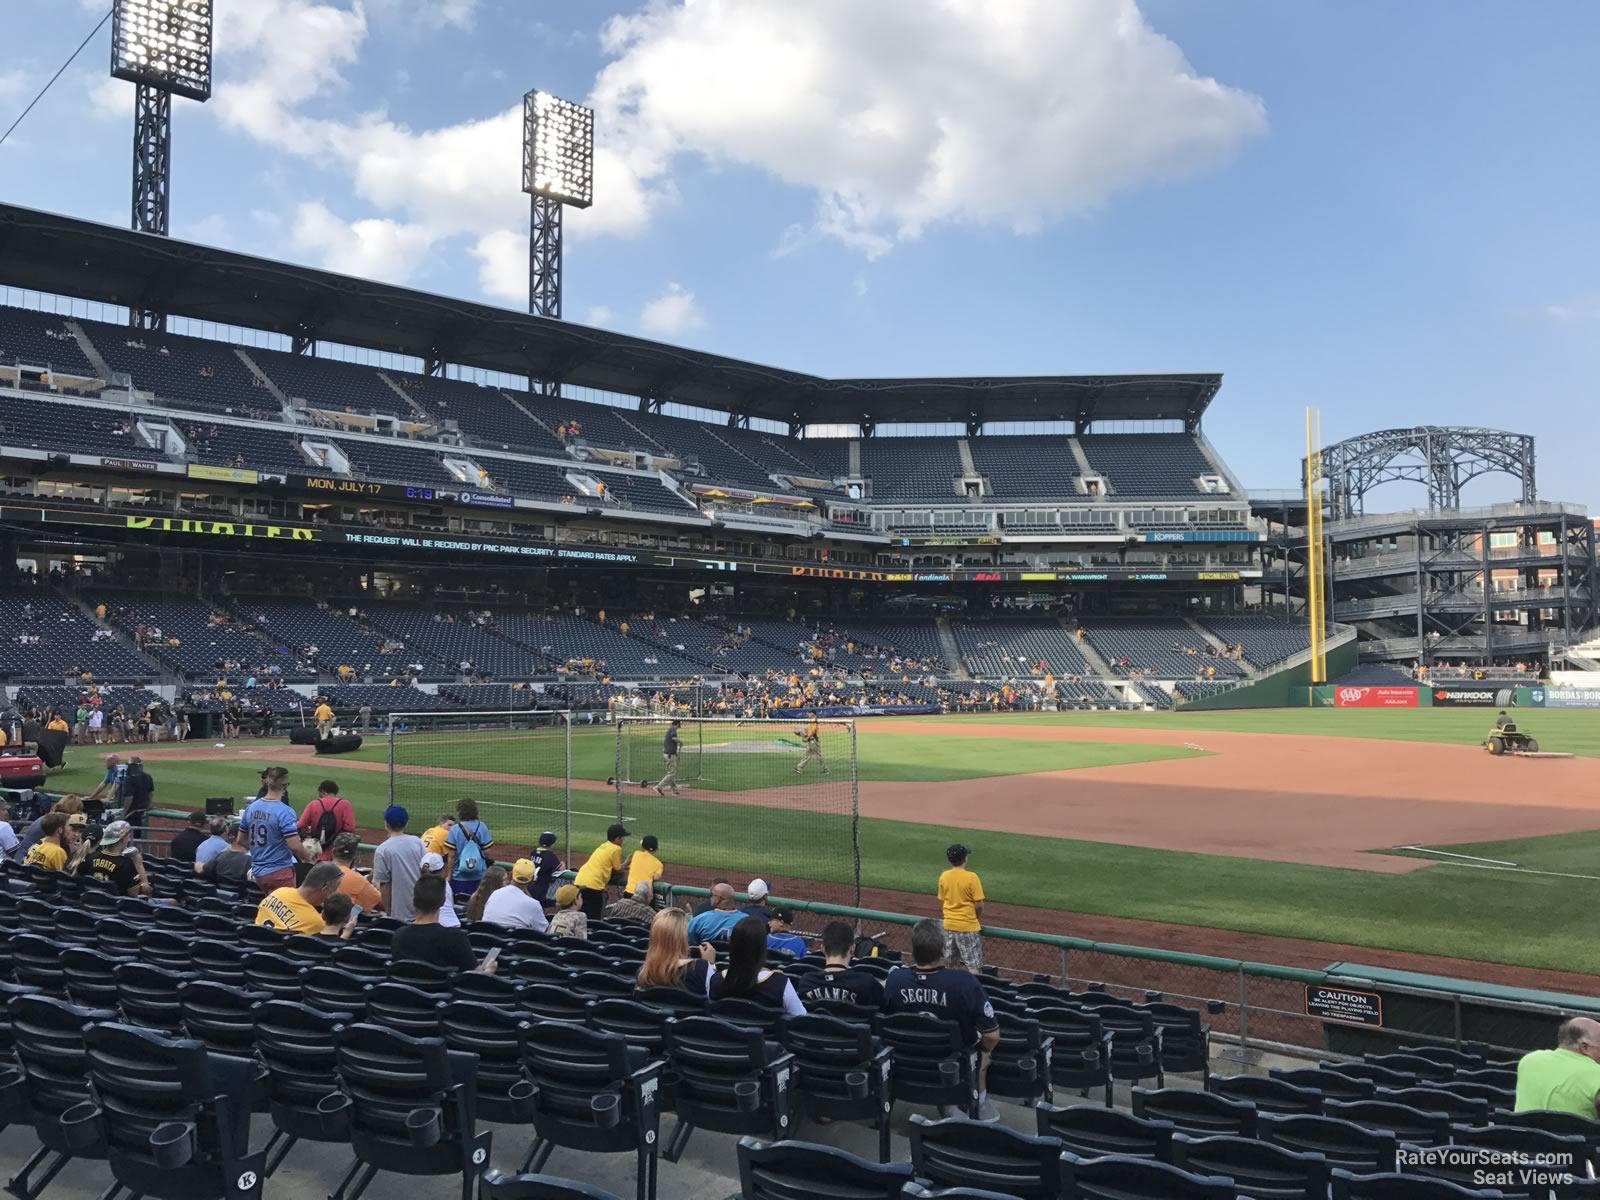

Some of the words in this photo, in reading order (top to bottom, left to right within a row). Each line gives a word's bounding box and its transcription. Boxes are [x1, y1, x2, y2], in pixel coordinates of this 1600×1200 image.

[104, 459, 121, 467] PAUL
[132, 461, 155, 470] WANER
[307, 478, 337, 491] MON,
[338, 482, 365, 493] JULY
[368, 484, 381, 494] 17
[472, 493, 511, 504] Consolidated
[1154, 532, 1184, 540] KOPPERS
[345, 533, 361, 542] THE
[363, 535, 400, 545] REQUEST
[402, 538, 421, 546] WILL
[434, 541, 470, 550] RECEIVED
[471, 543, 483, 551] BY
[483, 544, 499, 552] PNC
[500, 545, 519, 553] PARK
[520, 547, 555, 556] SECURITY.
[558, 550, 595, 559] STANDARD
[595, 553, 615, 561] RATES
[617, 554, 638, 562] APPLY.
[914, 573, 950, 581] Cardinals
[1549, 691, 1581, 699] BORDAS
[250, 824, 268, 847] 19
[92, 858, 116, 873] TABATA
[806, 987, 857, 1004] THAMES
[900, 988, 947, 1006] SEGURA
[1318, 990, 1367, 1004] CAUTION
[1331, 1012, 1365, 1021] TRESPASSING
[242, 1174, 253, 1188] K
